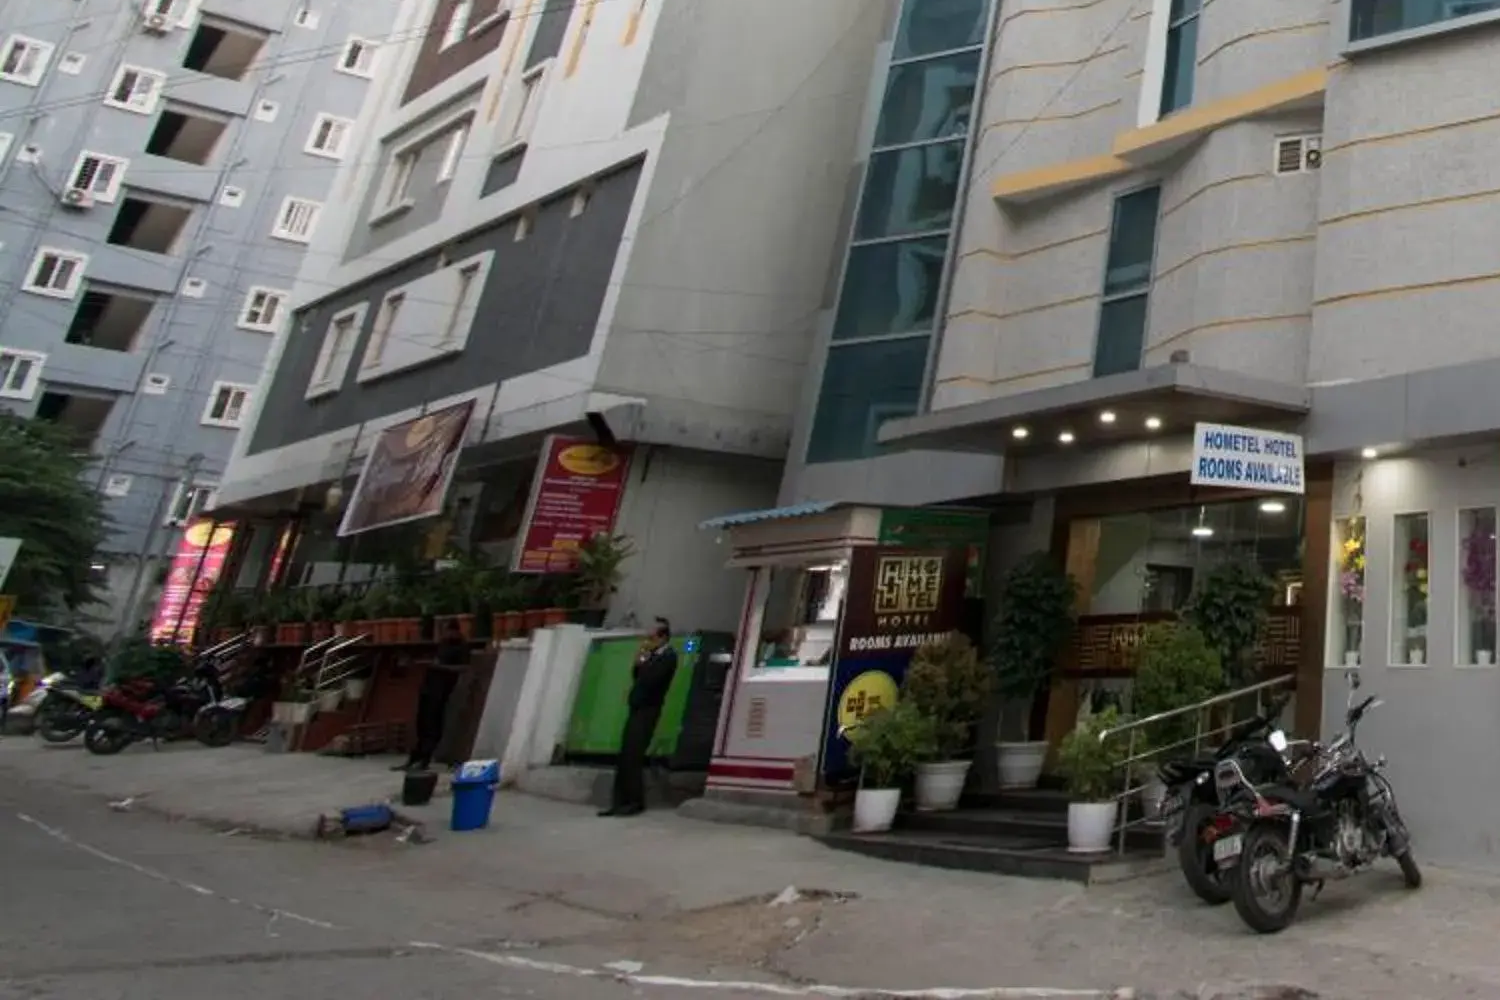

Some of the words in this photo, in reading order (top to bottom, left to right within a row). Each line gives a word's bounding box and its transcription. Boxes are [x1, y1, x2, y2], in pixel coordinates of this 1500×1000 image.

[1204, 431, 1261, 453] HOMETEL
[1264, 439, 1297, 458] HOTEL
[1199, 457, 1243, 480] ROOMS
[877, 614, 929, 627] HOTEL
[850, 635, 892, 651] ROOMS
